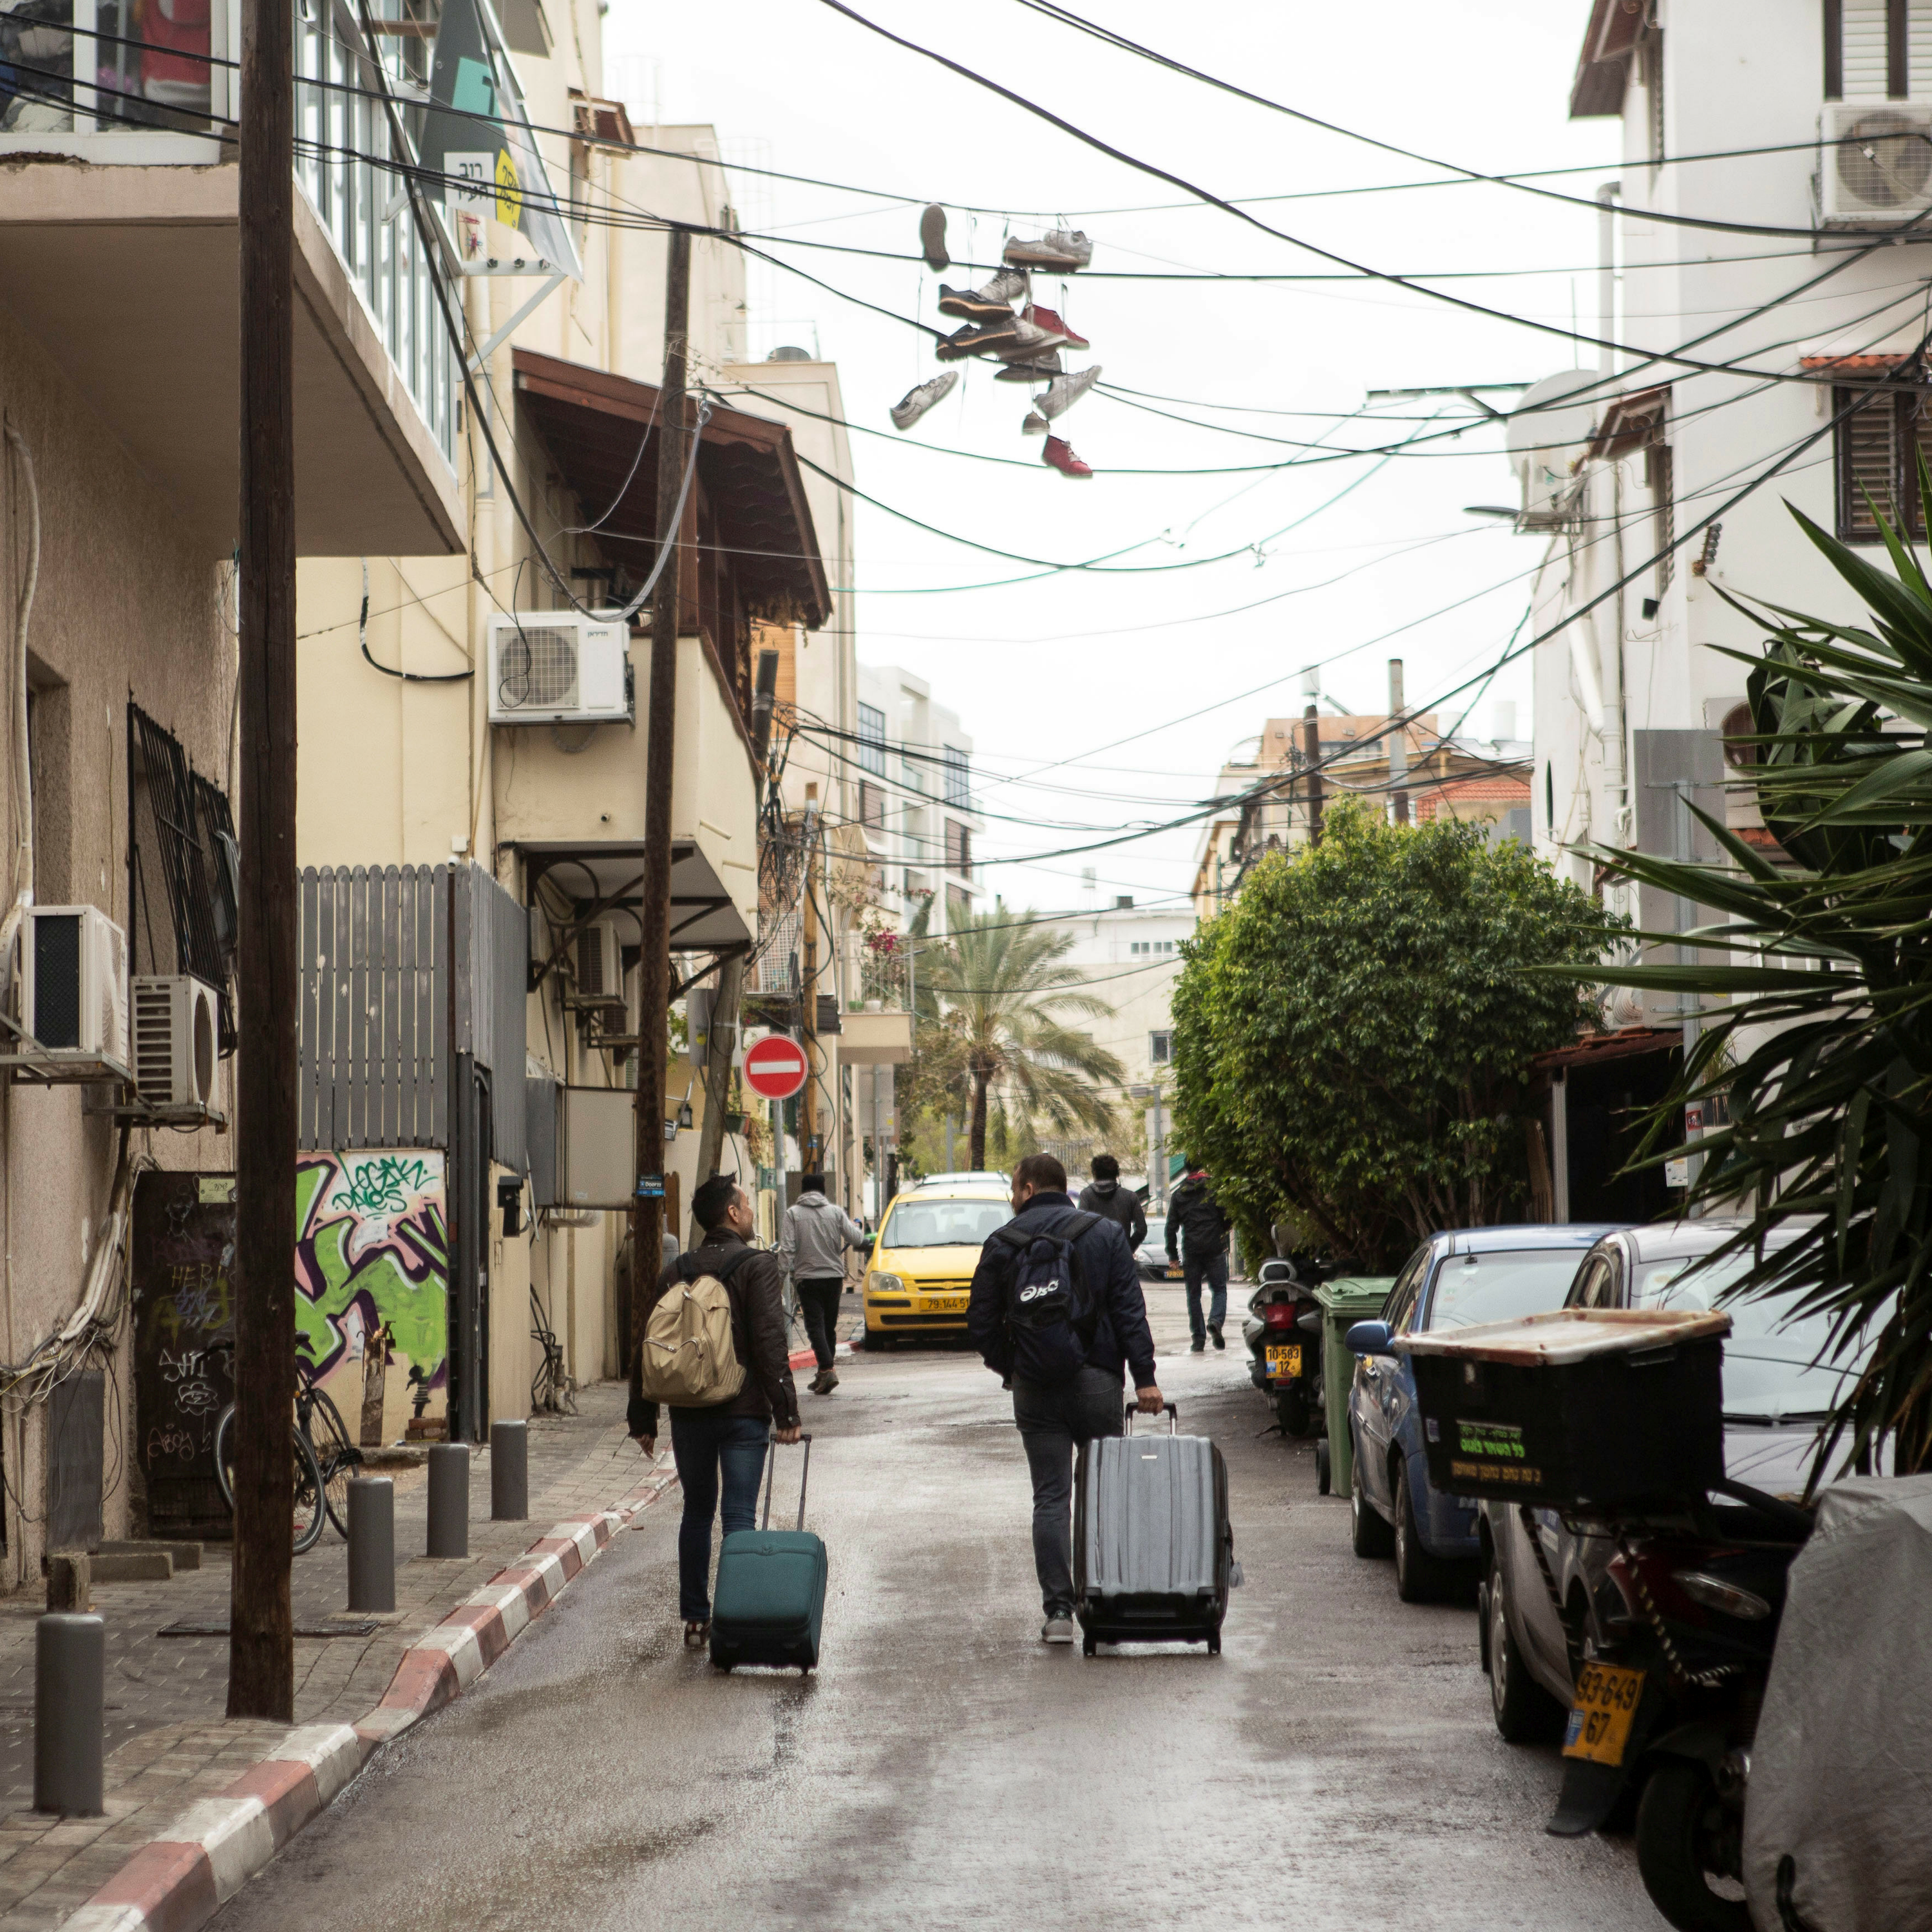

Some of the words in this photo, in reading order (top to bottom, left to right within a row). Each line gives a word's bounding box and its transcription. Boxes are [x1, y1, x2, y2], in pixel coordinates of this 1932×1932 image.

[459, 163, 482, 178] רוב
[1279, 1361, 1290, 1372] 12
[1585, 1710, 1611, 1745] 67
